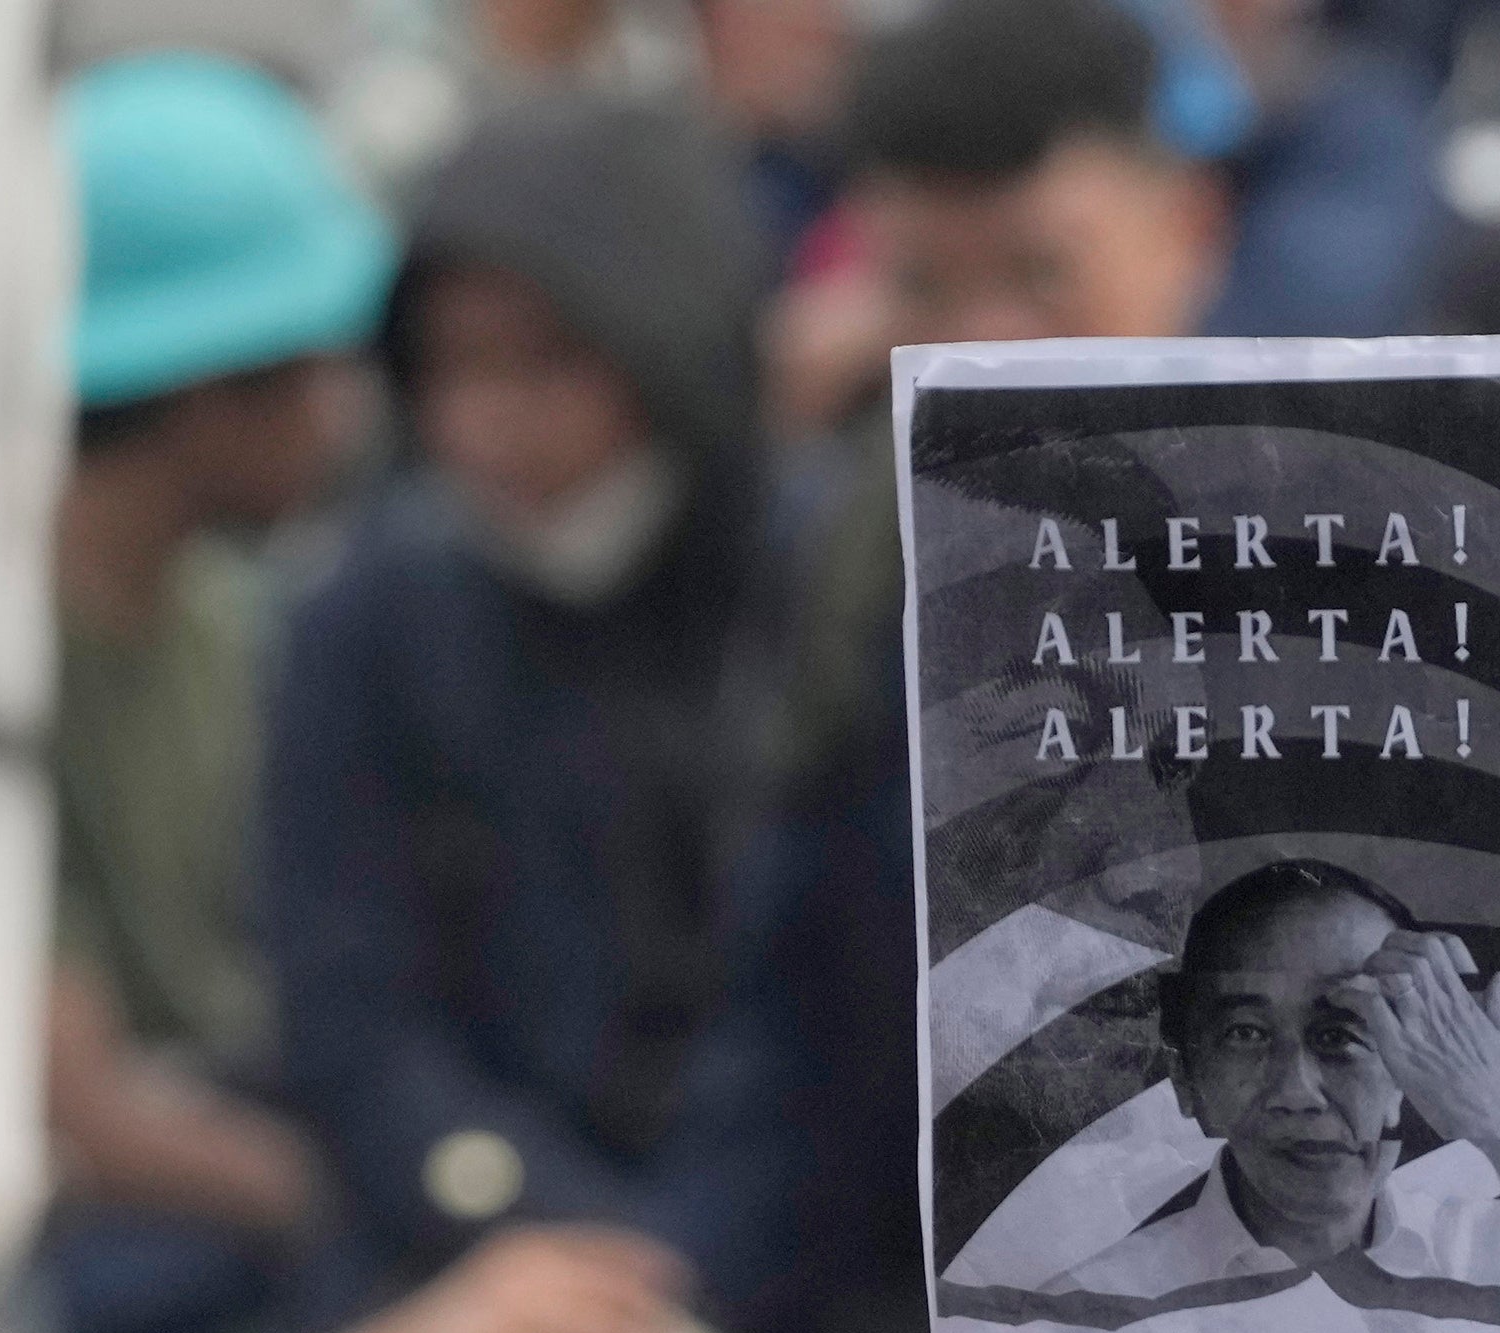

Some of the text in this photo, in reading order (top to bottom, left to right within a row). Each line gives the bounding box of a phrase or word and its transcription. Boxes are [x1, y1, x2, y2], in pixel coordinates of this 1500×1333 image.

[1028, 503, 1468, 572] ALERTA!
[1031, 601, 1471, 666] ALERTA!
[1035, 697, 1472, 762] ALERTA!
